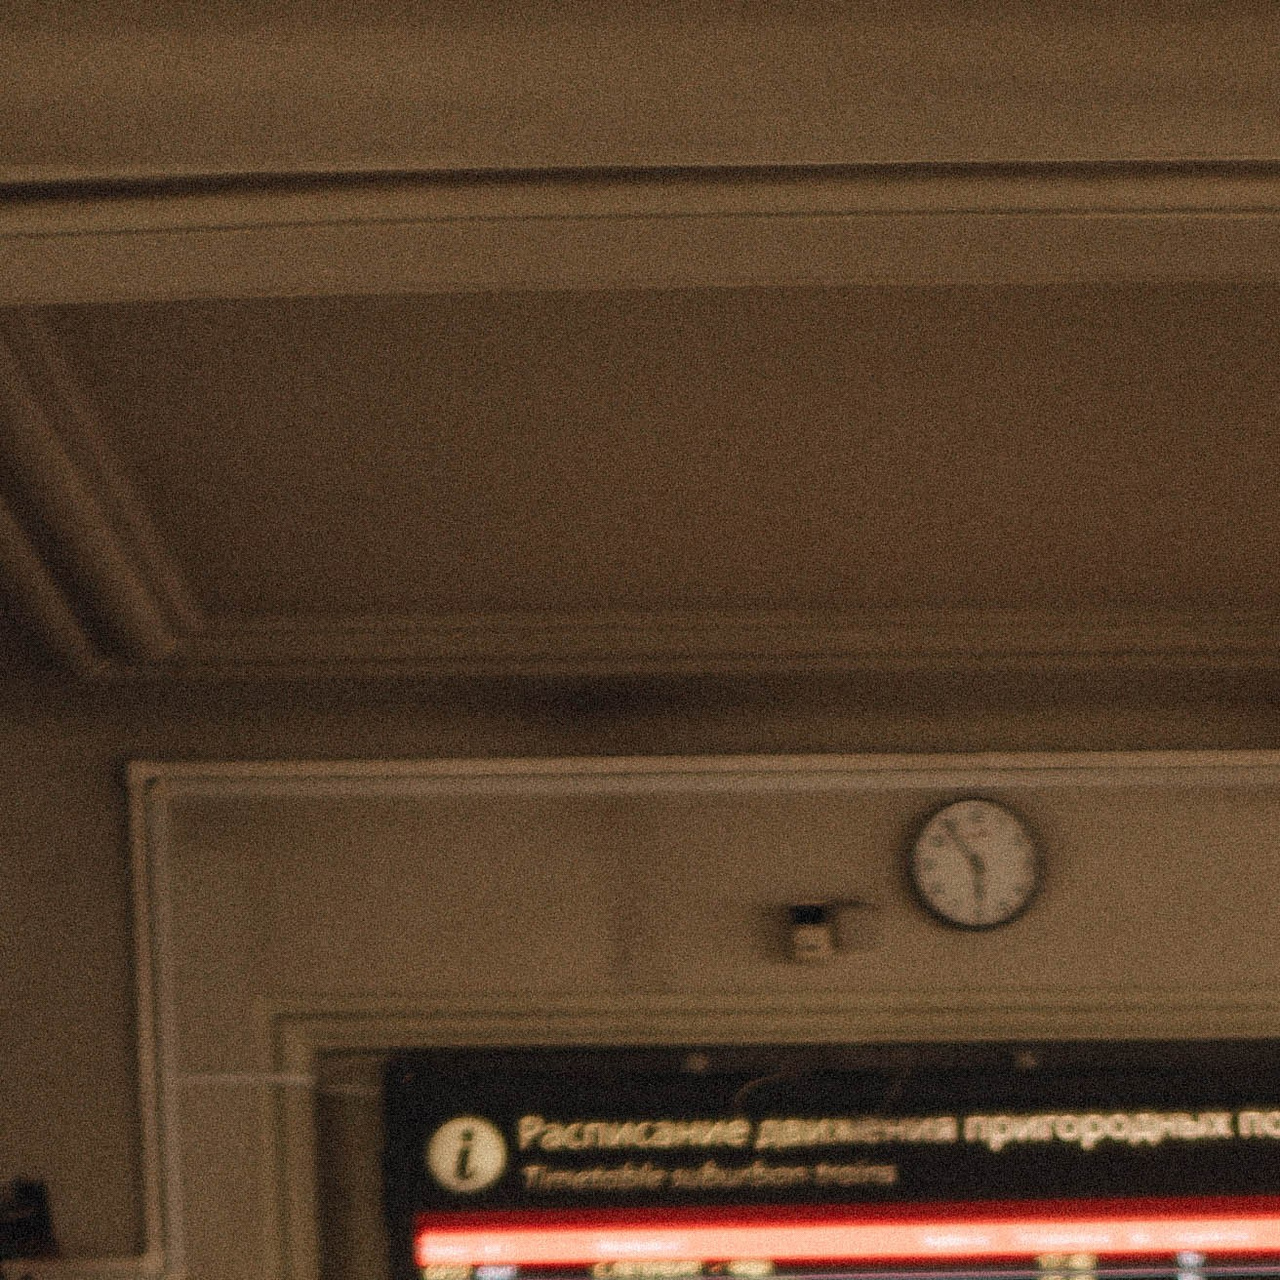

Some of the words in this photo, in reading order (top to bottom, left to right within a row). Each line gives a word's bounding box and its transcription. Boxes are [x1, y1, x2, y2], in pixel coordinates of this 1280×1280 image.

[517, 1114, 750, 1150] Расписание
[755, 1115, 957, 1149] движения
[963, 1111, 1233, 1152] пригородных
